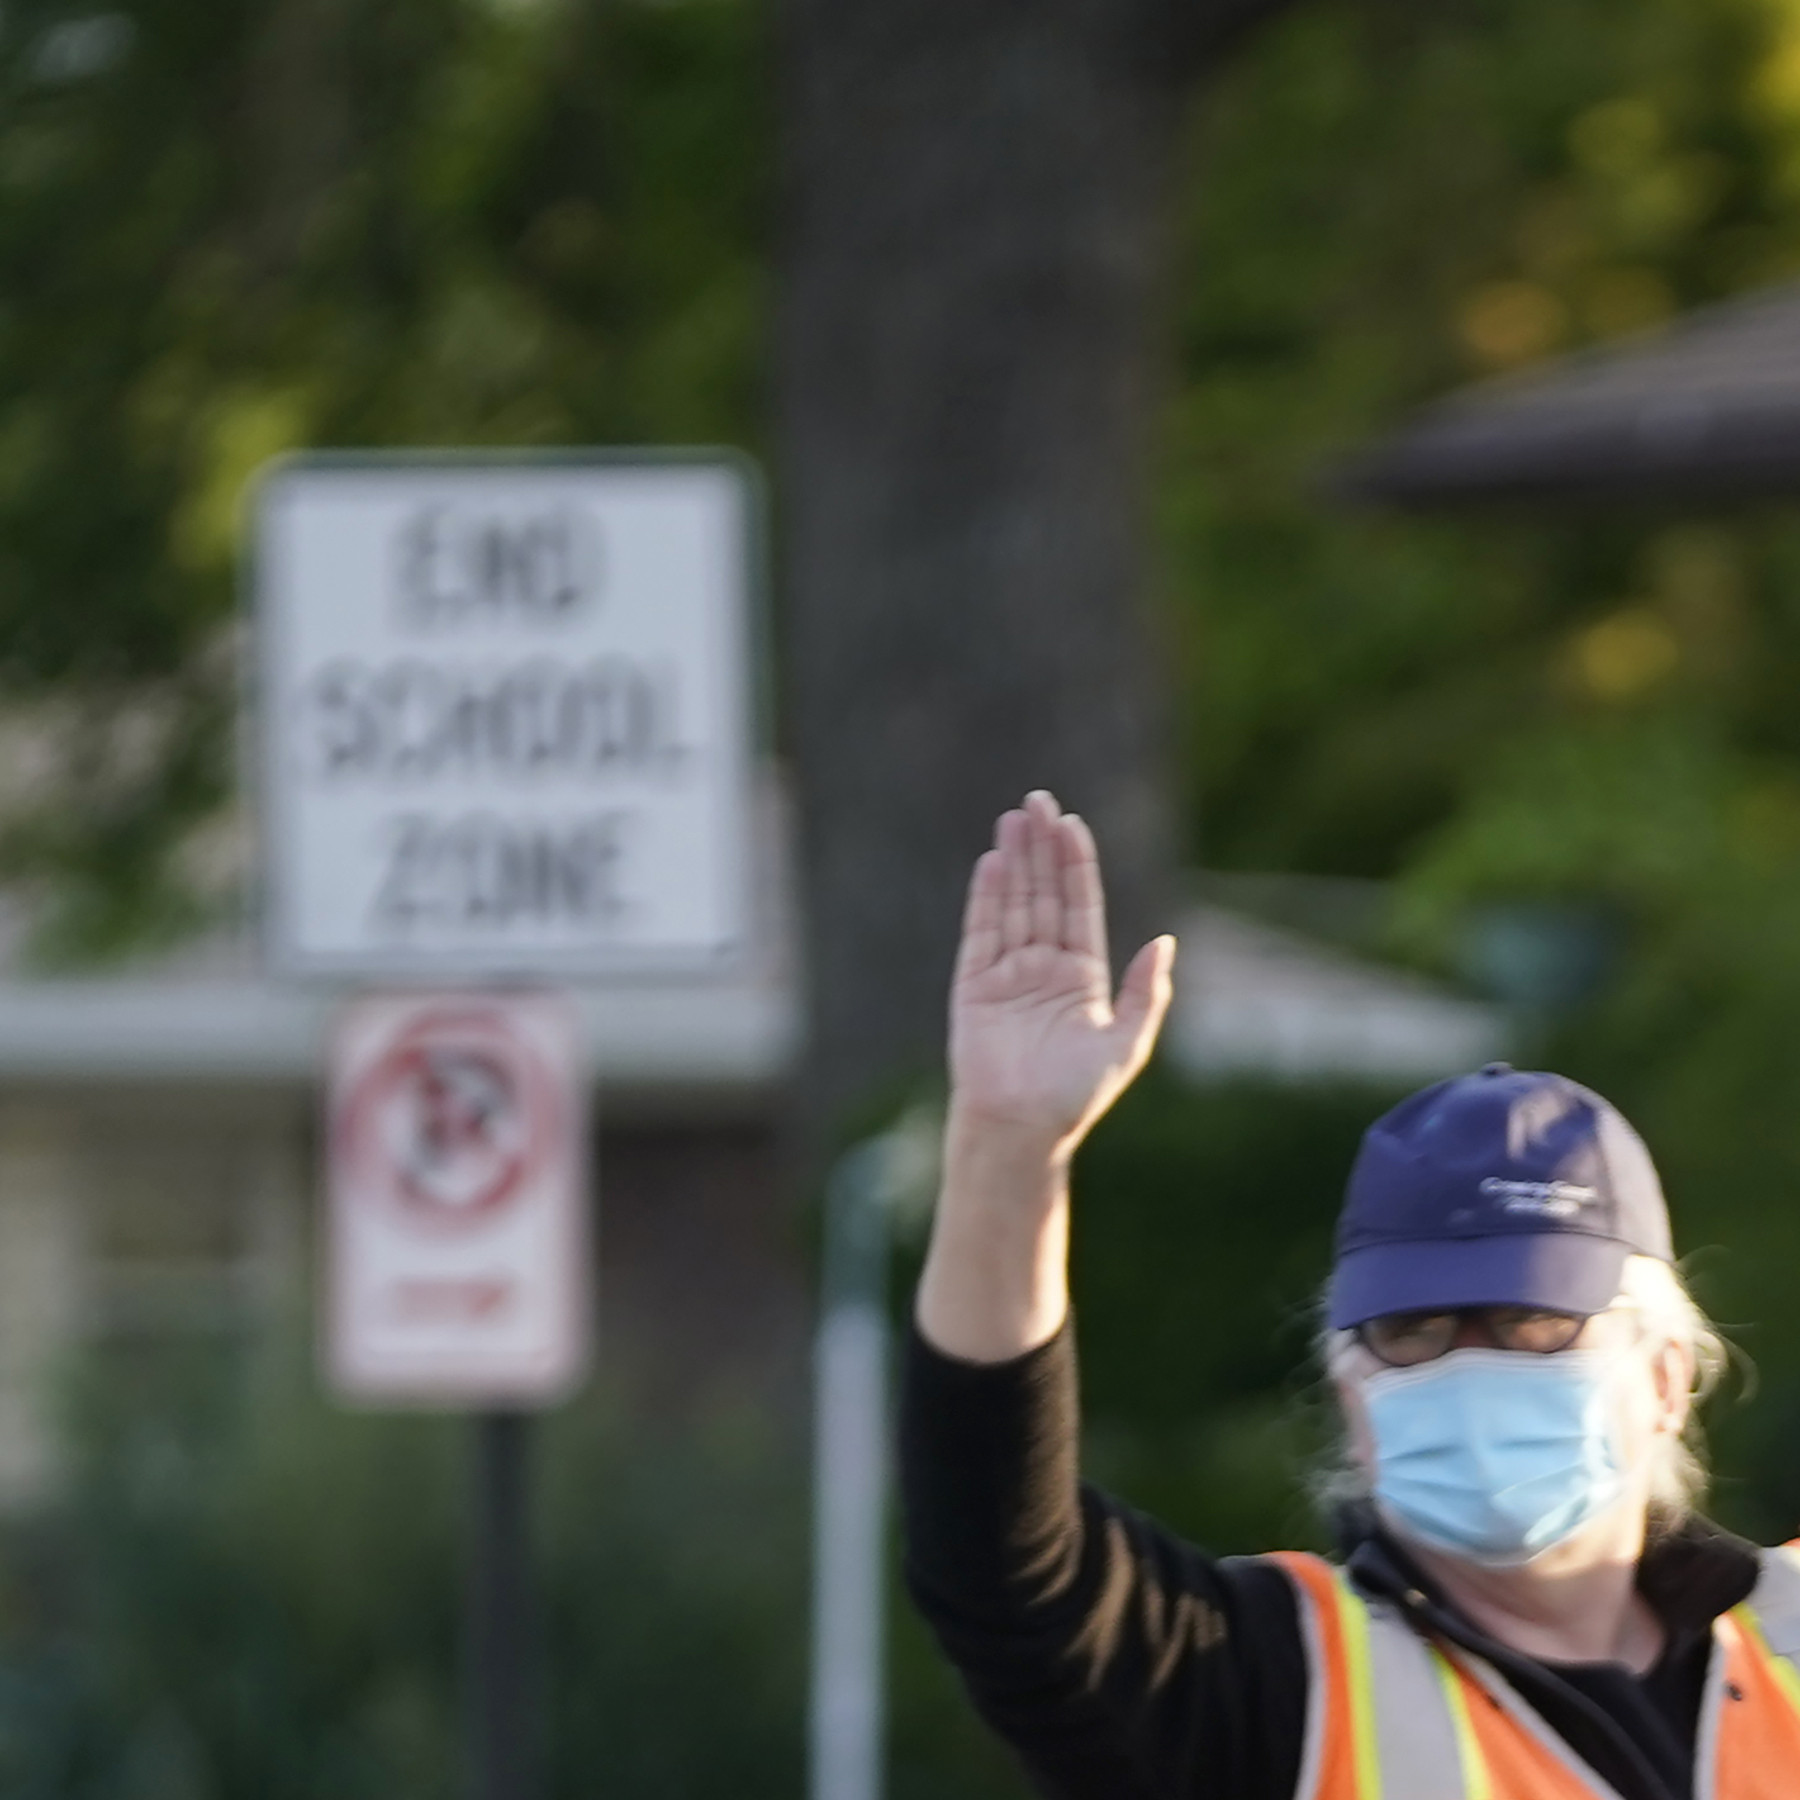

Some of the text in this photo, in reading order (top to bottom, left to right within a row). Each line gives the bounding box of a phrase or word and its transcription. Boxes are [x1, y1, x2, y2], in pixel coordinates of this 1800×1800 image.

[398, 502, 602, 626] END
[314, 658, 694, 780] SCHOOL
[376, 814, 636, 928] ZONE
